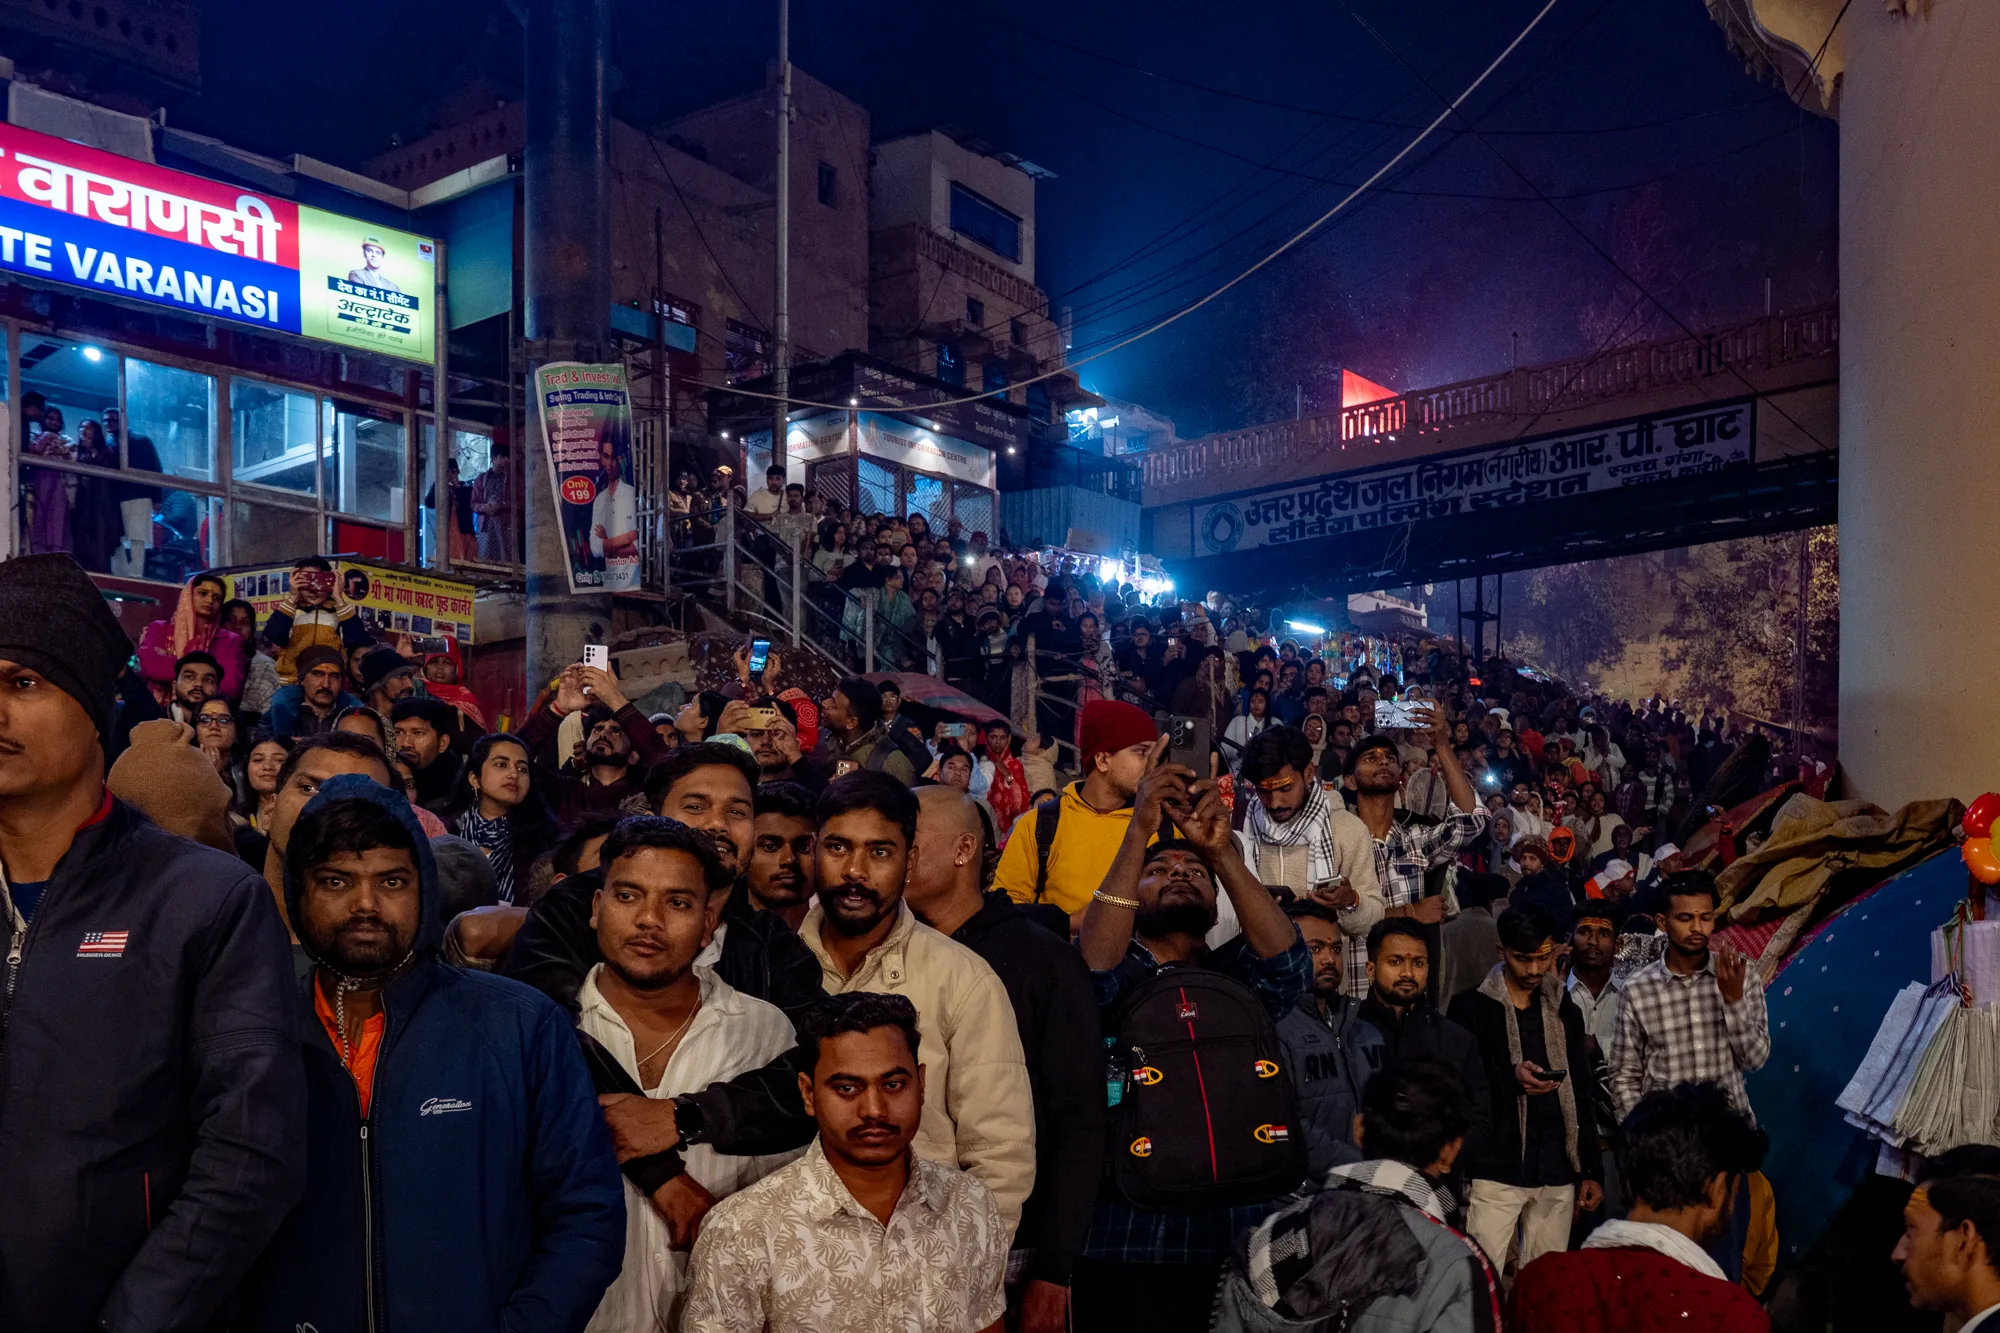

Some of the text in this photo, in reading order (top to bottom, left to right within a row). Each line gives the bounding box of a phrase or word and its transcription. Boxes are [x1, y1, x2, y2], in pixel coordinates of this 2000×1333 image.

[15, 153, 282, 264] वाराणसी
[64, 242, 279, 324] VARANASI
[337, 280, 353, 294] देश
[355, 285, 367, 298] का
[386, 292, 410, 307] सीमेंट
[338, 299, 410, 324] अल्ट्राटेक
[544, 372, 568, 386] Trad
[570, 370, 580, 382] &
[582, 370, 610, 384] Invest
[549, 392, 572, 403] Swing
[572, 390, 598, 402] Trading
[883, 432, 967, 465] TOURIST INFORMATION CENTRE
[1244, 494, 1298, 526] उत्तर
[1297, 480, 1360, 518] प्रदेश
[1360, 473, 1413, 507] जल
[1416, 458, 1484, 497] निगम
[1663, 408, 1743, 449] घाट
[567, 480, 589, 489] Only
[569, 490, 590, 501] 199
[1268, 515, 1353, 544] सीवेज
[576, 572, 593, 584] Only
[371, 579, 382, 601] श्री
[384, 582, 394, 602] मां
[396, 583, 413, 606] गंगा
[420, 1097, 473, 1117] Generation
